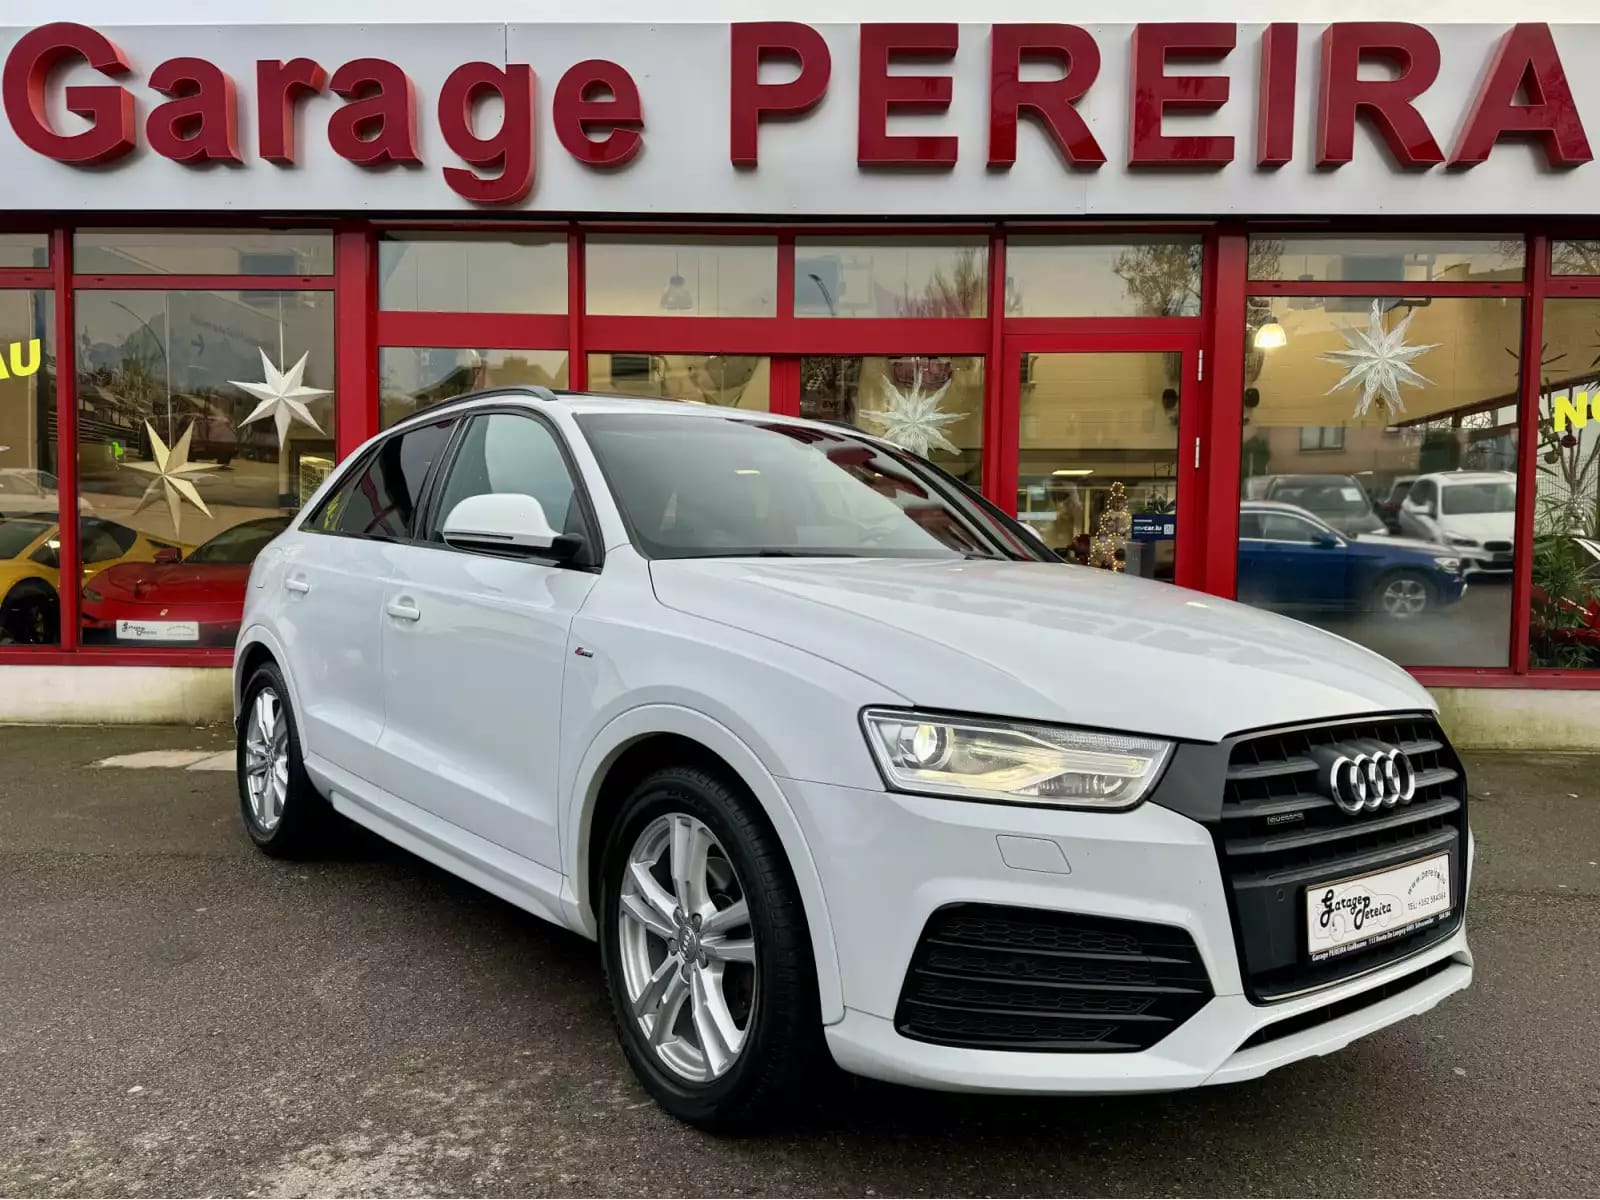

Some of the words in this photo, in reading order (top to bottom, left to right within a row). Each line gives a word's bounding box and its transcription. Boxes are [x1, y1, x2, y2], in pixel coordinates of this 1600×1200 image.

[2, 22, 646, 204] Garage
[730, 21, 1594, 168] PEREIRA
[0, 338, 41, 379] U
[1554, 391, 1600, 433] N
[1320, 889, 1362, 928] Garage
[1354, 895, 1392, 930] Pereira
